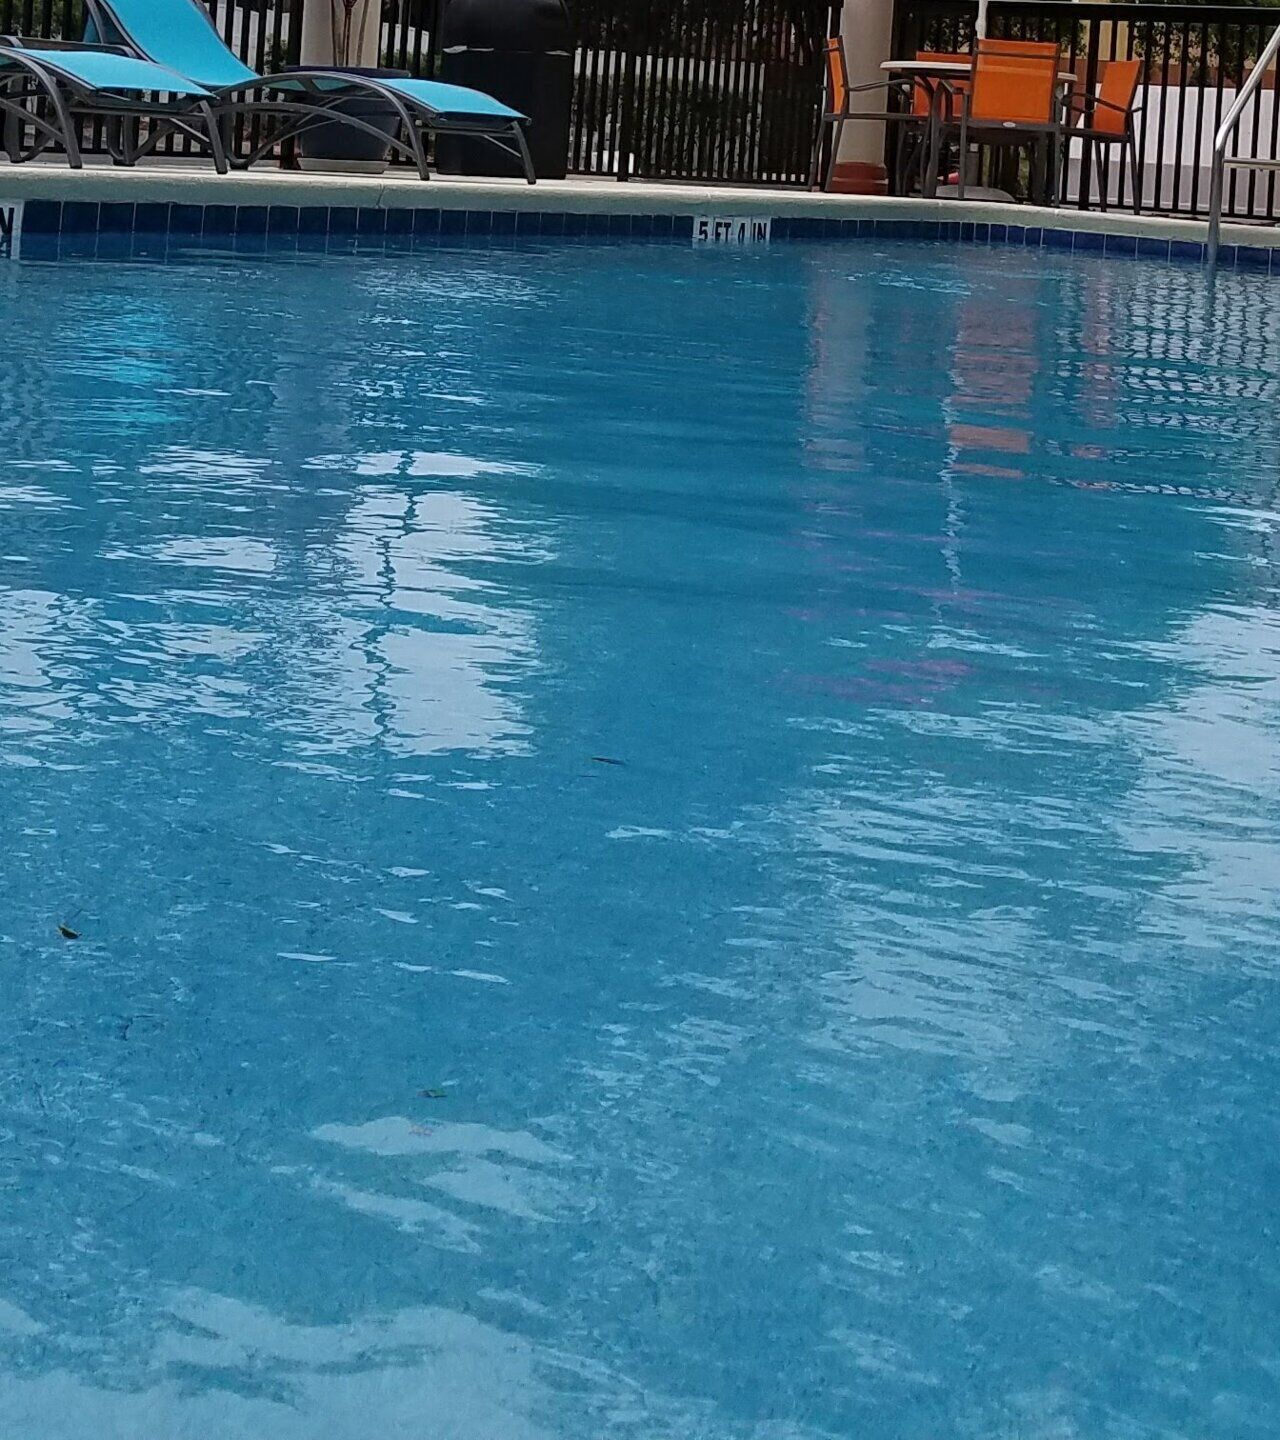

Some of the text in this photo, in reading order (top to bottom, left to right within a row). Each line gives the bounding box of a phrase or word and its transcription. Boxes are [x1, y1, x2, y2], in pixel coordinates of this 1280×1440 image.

[698, 220, 709, 241] 5
[714, 221, 731, 241] FT
[753, 222, 767, 241] IN
